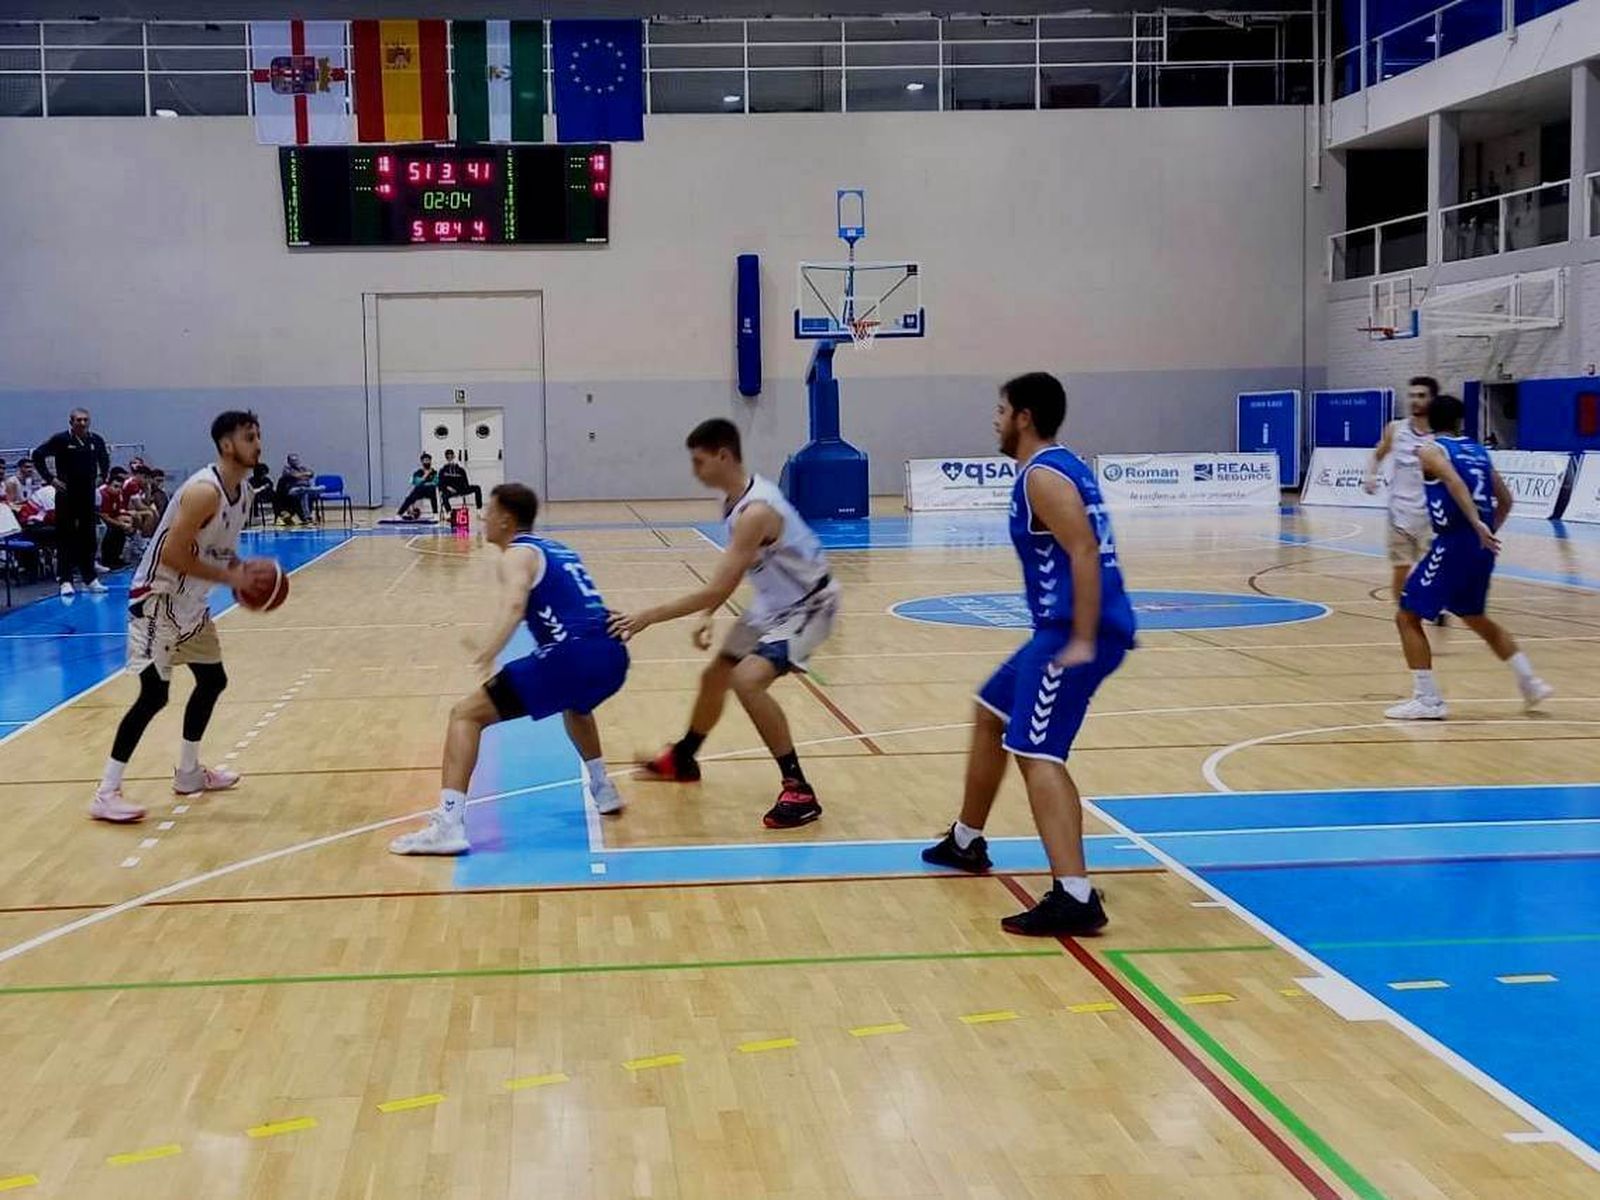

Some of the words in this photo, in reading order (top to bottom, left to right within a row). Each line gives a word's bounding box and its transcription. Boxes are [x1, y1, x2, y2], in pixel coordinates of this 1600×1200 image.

[408, 162, 431, 180] 51
[442, 163, 452, 178] 3
[468, 163, 490, 179] 41
[423, 191, 471, 209] 02:04
[474, 221, 484, 235] 4
[1125, 466, 1179, 478] Roman
[1217, 463, 1271, 473] REALE
[1217, 473, 1272, 481] SEGUROS
[1469, 468, 1487, 501] 2
[1503, 475, 1557, 498] ENTRO
